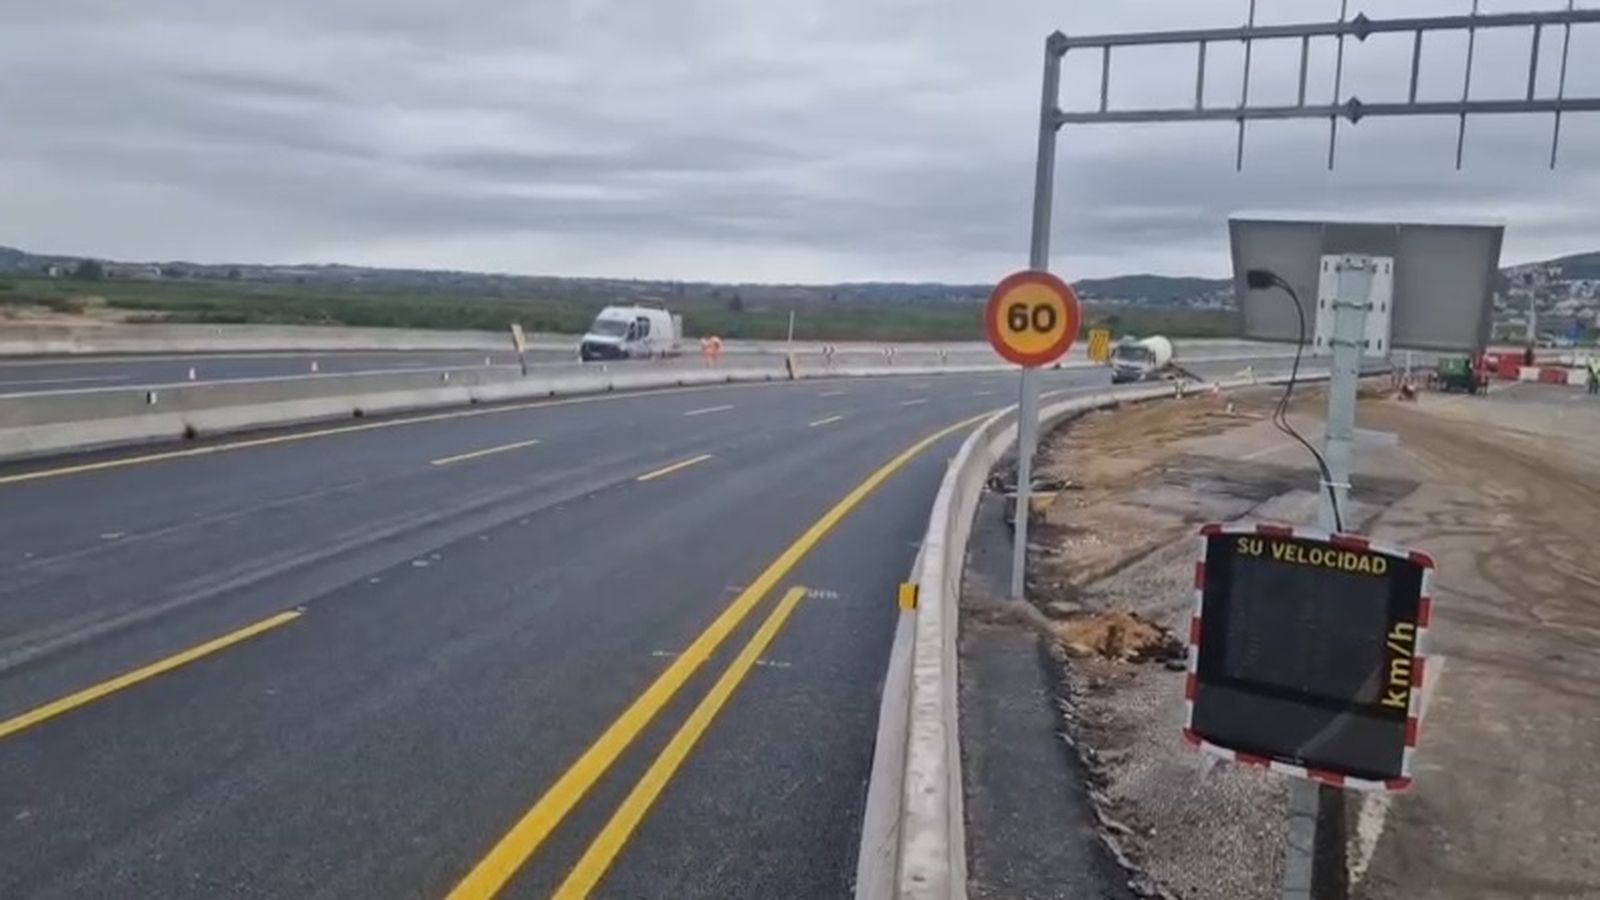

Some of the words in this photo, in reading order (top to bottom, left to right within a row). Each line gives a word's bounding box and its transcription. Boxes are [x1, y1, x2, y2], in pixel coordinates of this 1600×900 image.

[1007, 303, 1057, 333] 60
[1237, 537, 1263, 556] SU
[1271, 541, 1388, 575] VELOCIDAD
[1382, 621, 1414, 708] km/h
